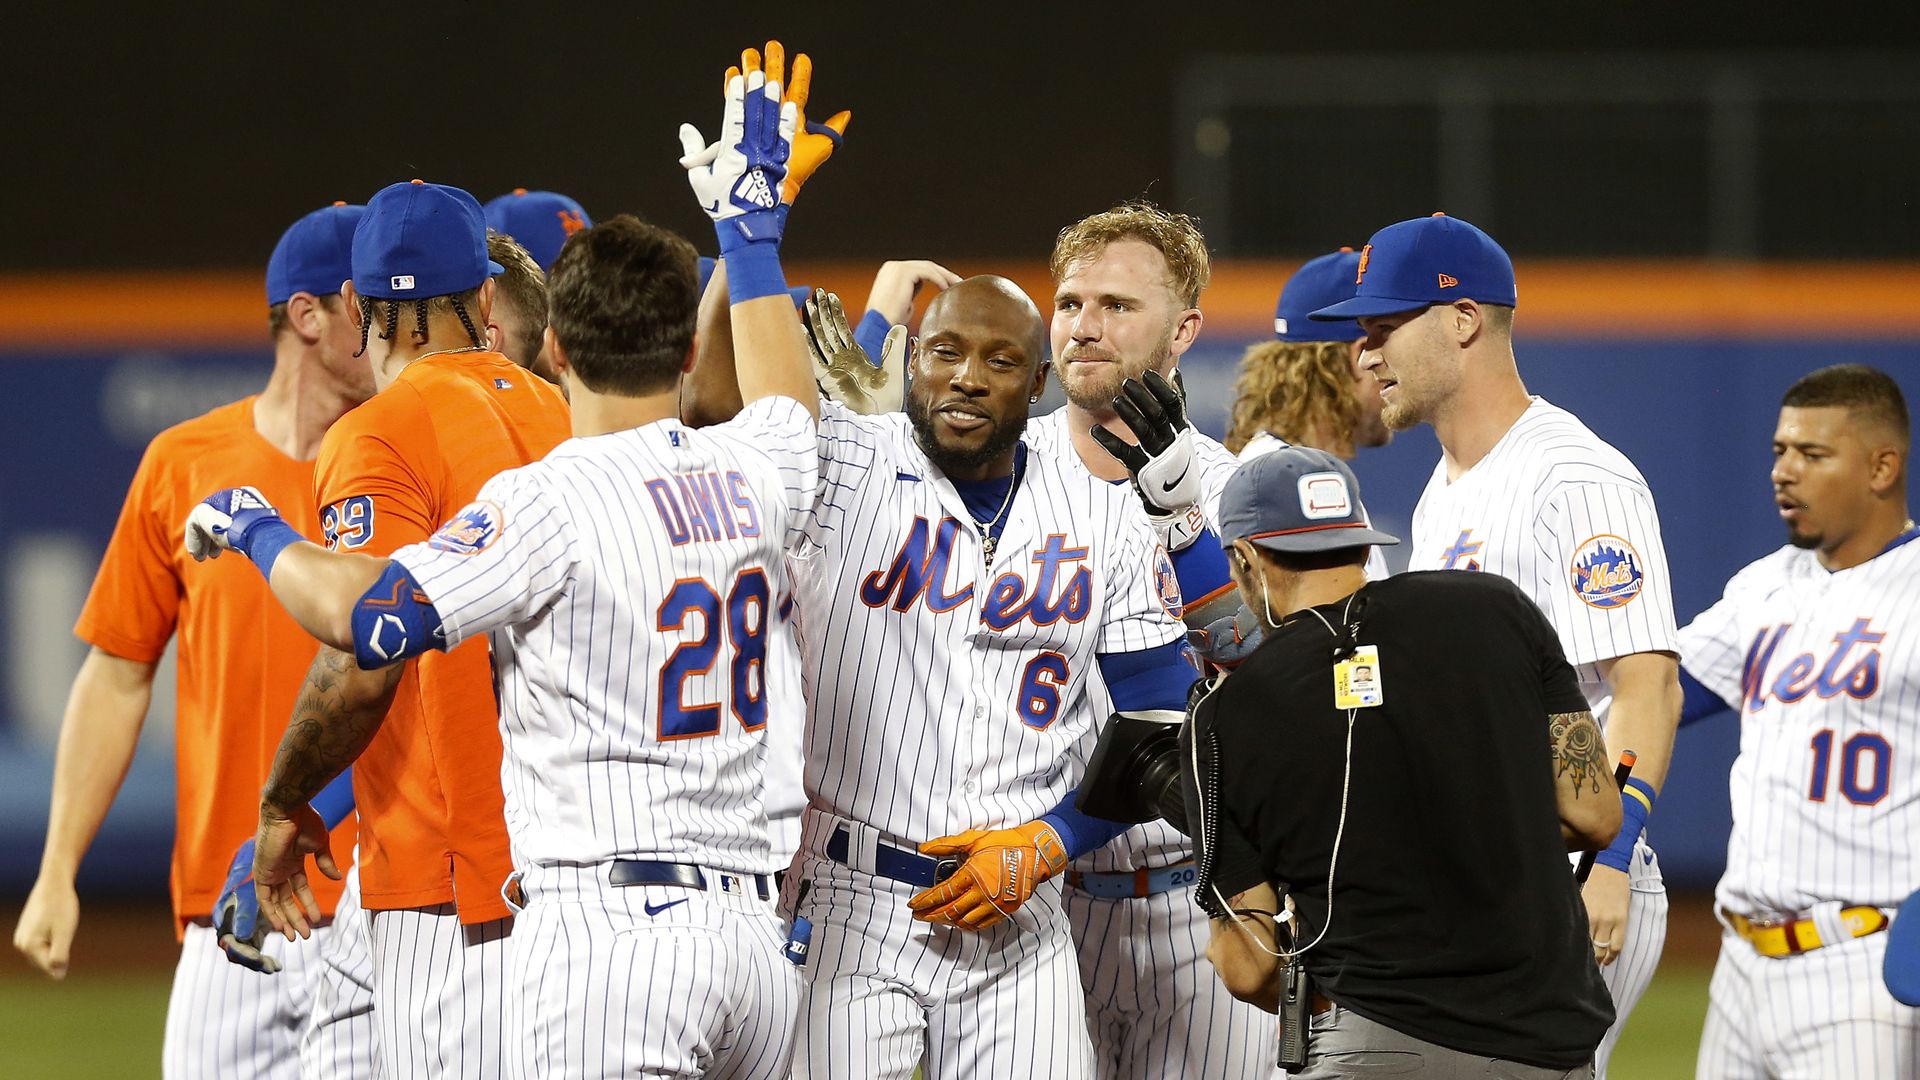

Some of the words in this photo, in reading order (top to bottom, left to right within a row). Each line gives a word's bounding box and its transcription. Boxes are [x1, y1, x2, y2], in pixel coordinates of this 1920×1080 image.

[644, 470, 761, 547] DAVIS
[1186, 504, 1203, 532] 20
[859, 514, 1093, 632] Mets
[1583, 561, 1633, 593] Mets
[656, 566, 771, 743] 28
[1015, 650, 1071, 733] 6
[1742, 617, 1888, 714] Mets
[1807, 727, 1893, 807] 10
[1170, 868, 1195, 886] 20
